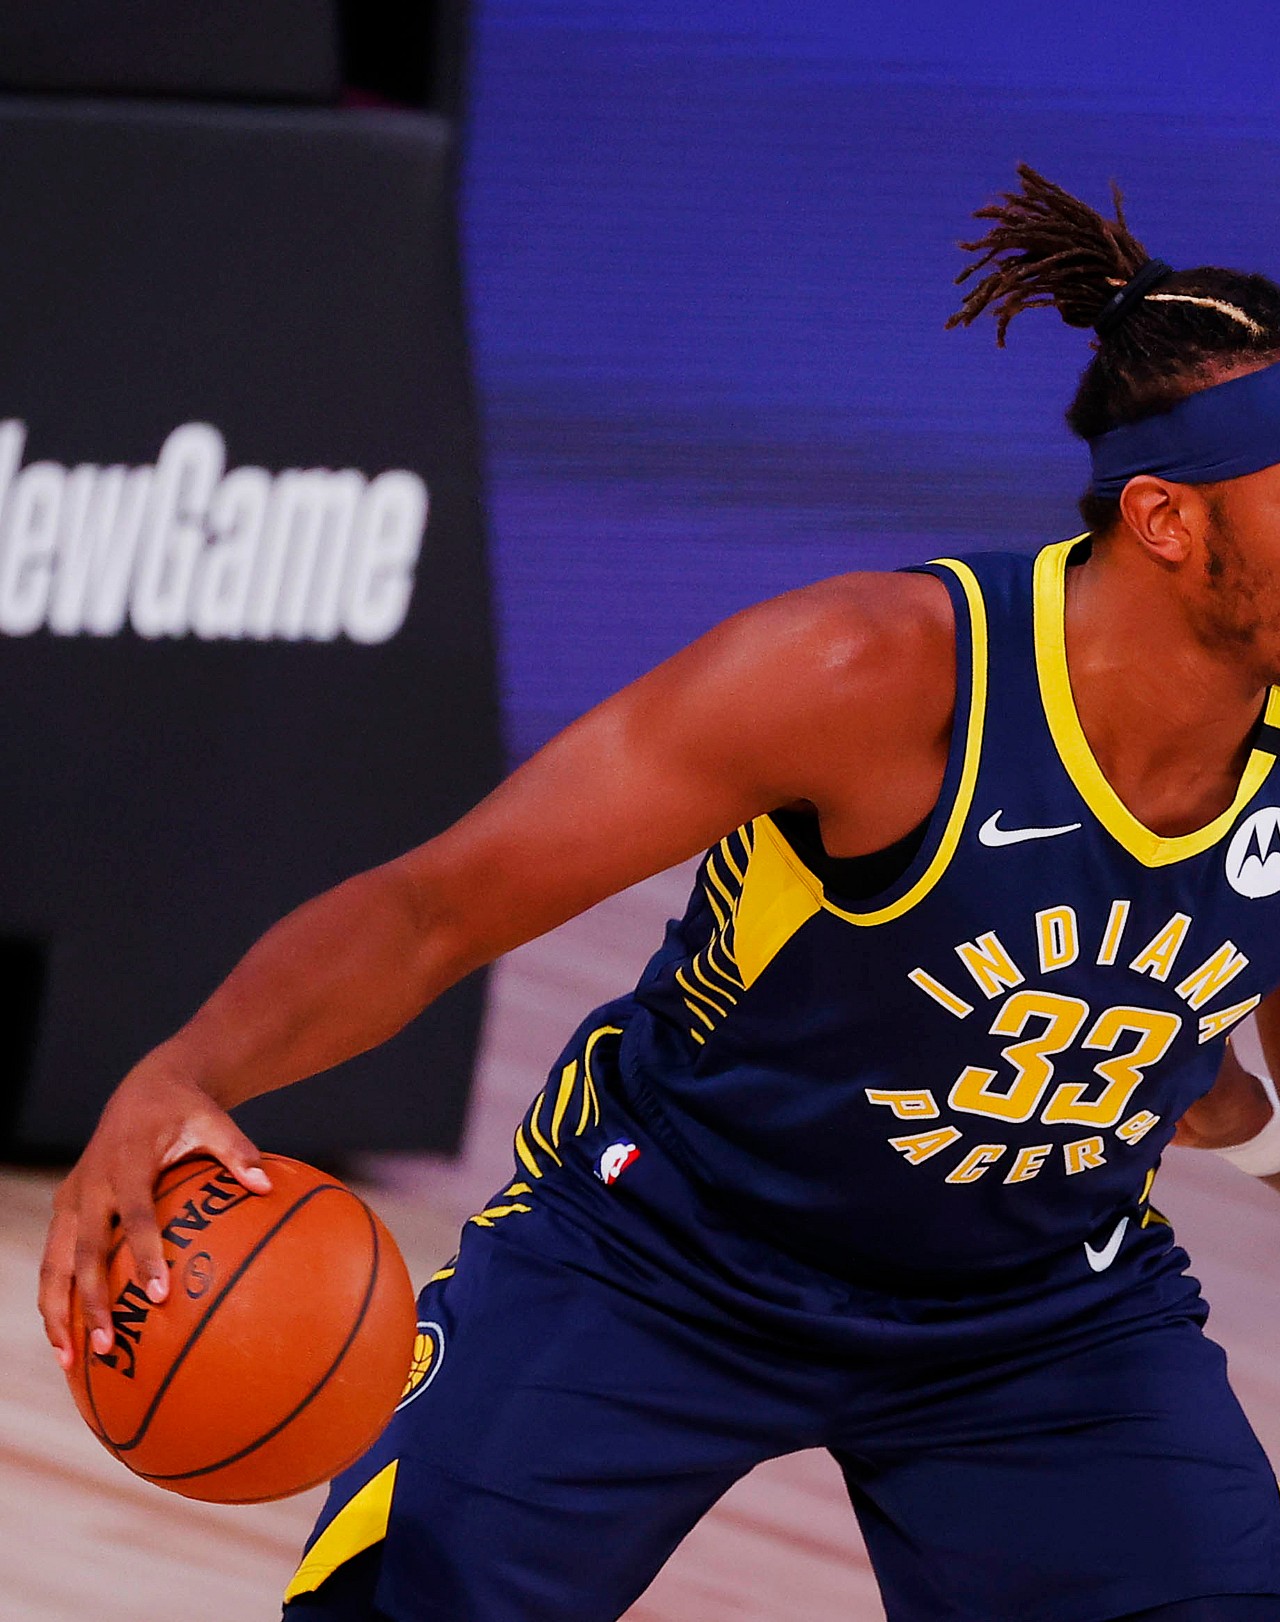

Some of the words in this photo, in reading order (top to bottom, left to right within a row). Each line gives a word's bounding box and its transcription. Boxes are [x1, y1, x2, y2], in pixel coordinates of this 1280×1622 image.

[907, 900, 1262, 1044] INDIANA
[947, 990, 1182, 1129] 33
[864, 1088, 1160, 1184] PACERS
